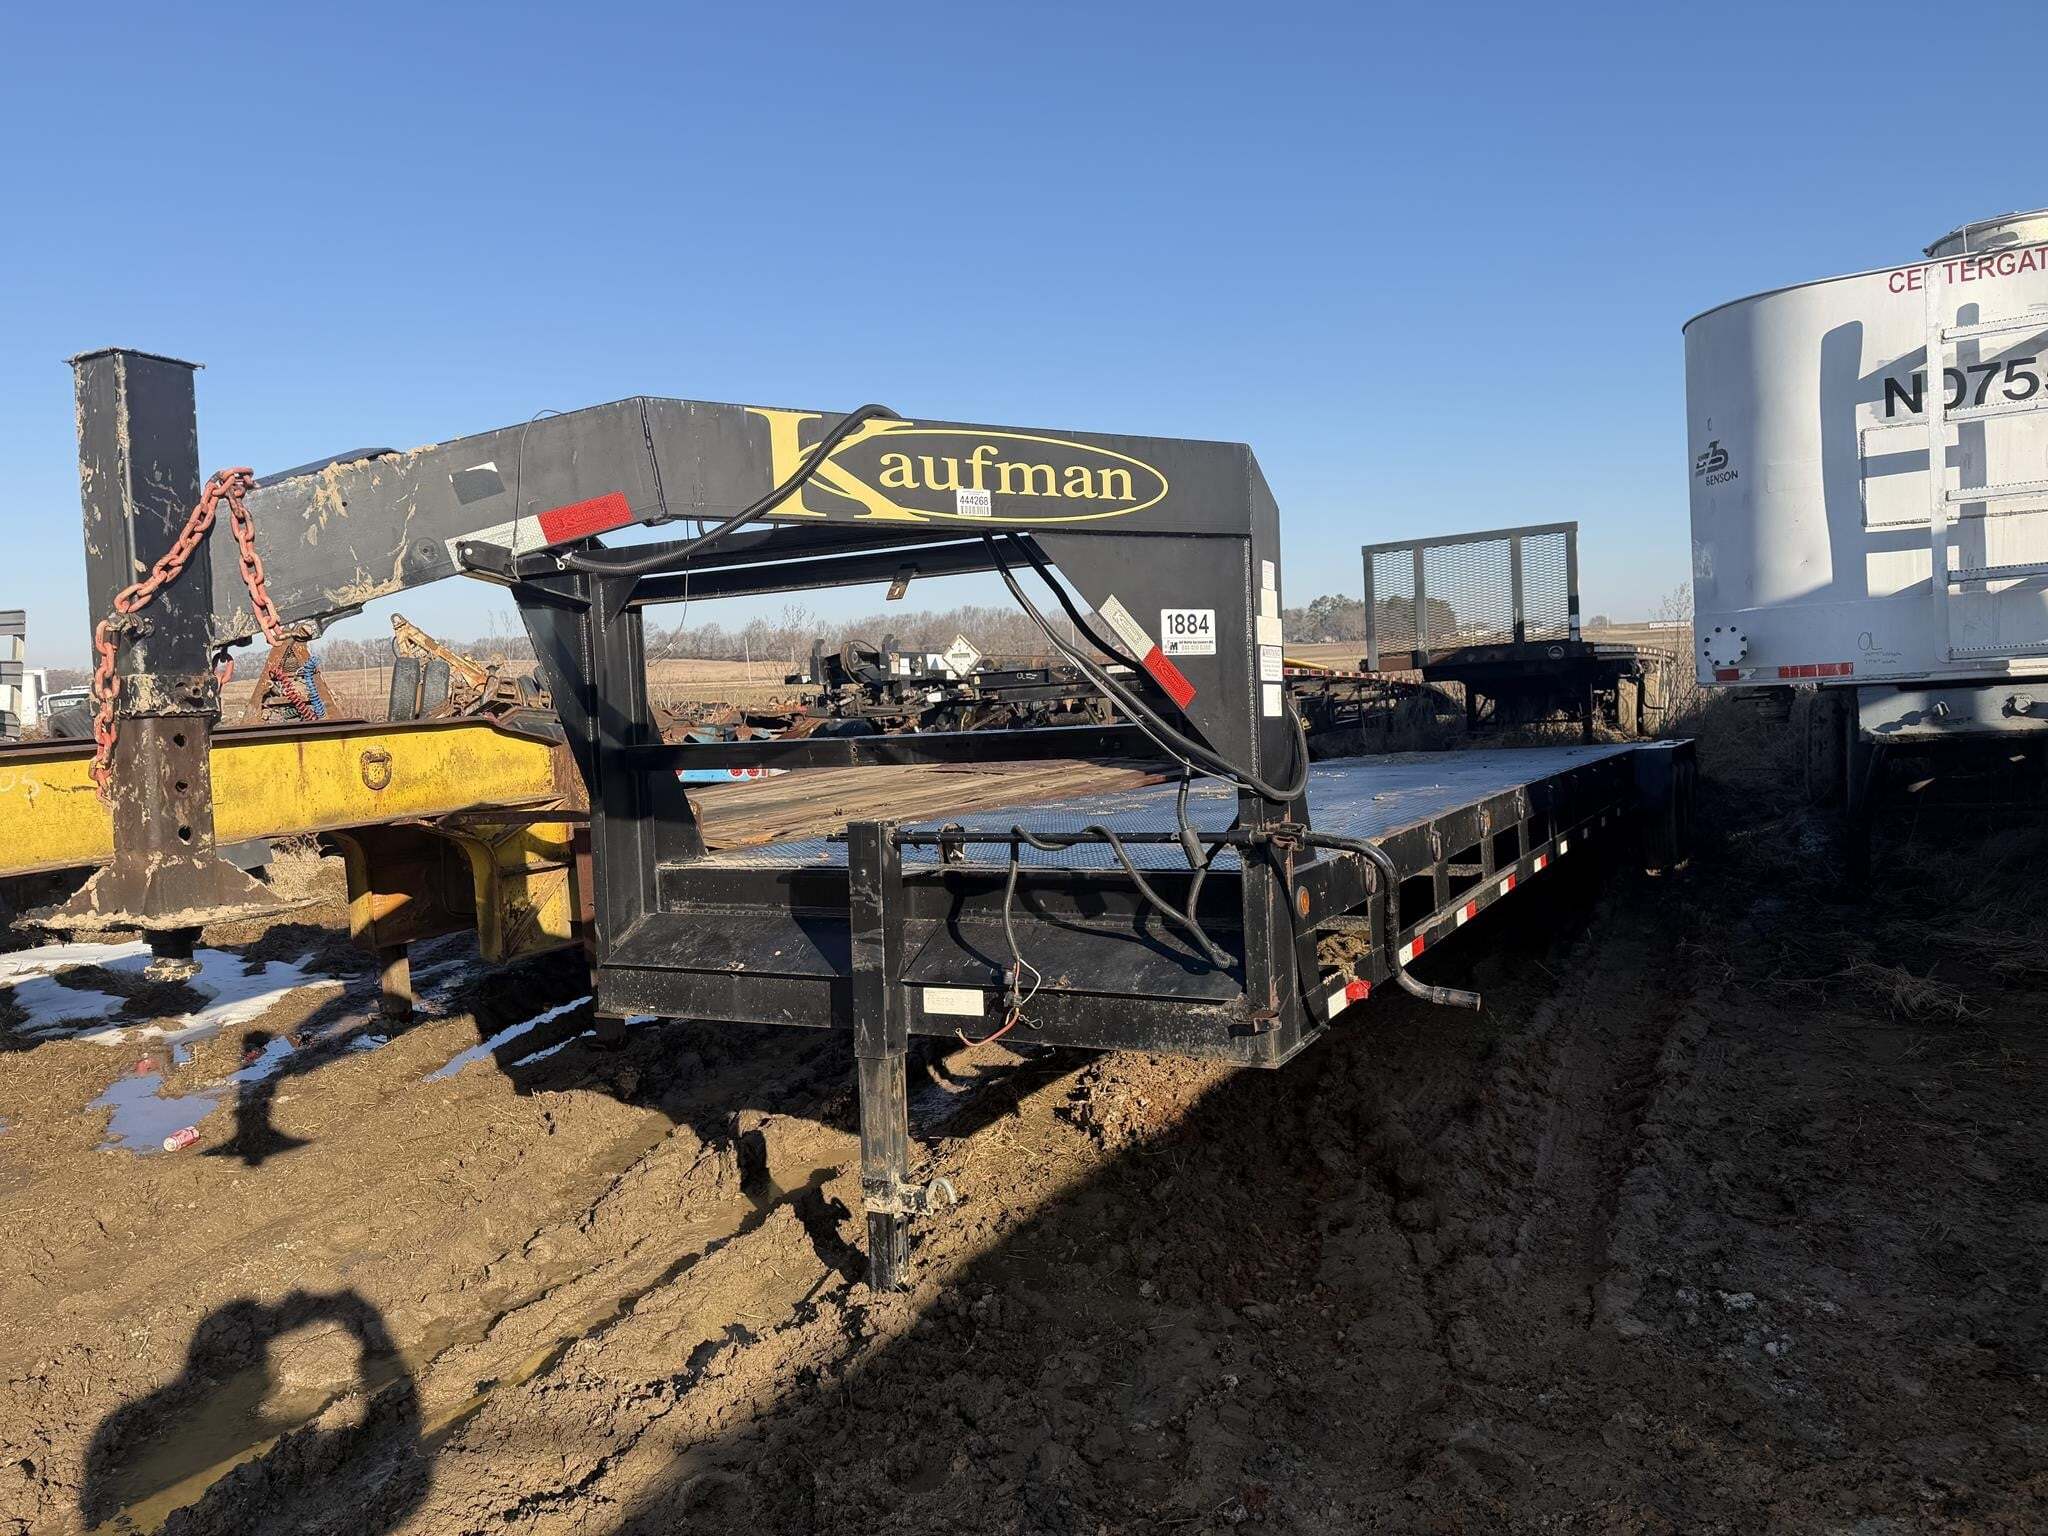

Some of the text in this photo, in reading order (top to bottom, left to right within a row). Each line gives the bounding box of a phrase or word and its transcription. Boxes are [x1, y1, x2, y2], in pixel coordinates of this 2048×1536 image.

[1889, 247, 2048, 294] CETERGAT
[744, 407, 1137, 522] Kaufman
[959, 495, 989, 506] 444268
[1167, 613, 1210, 635] 1884
